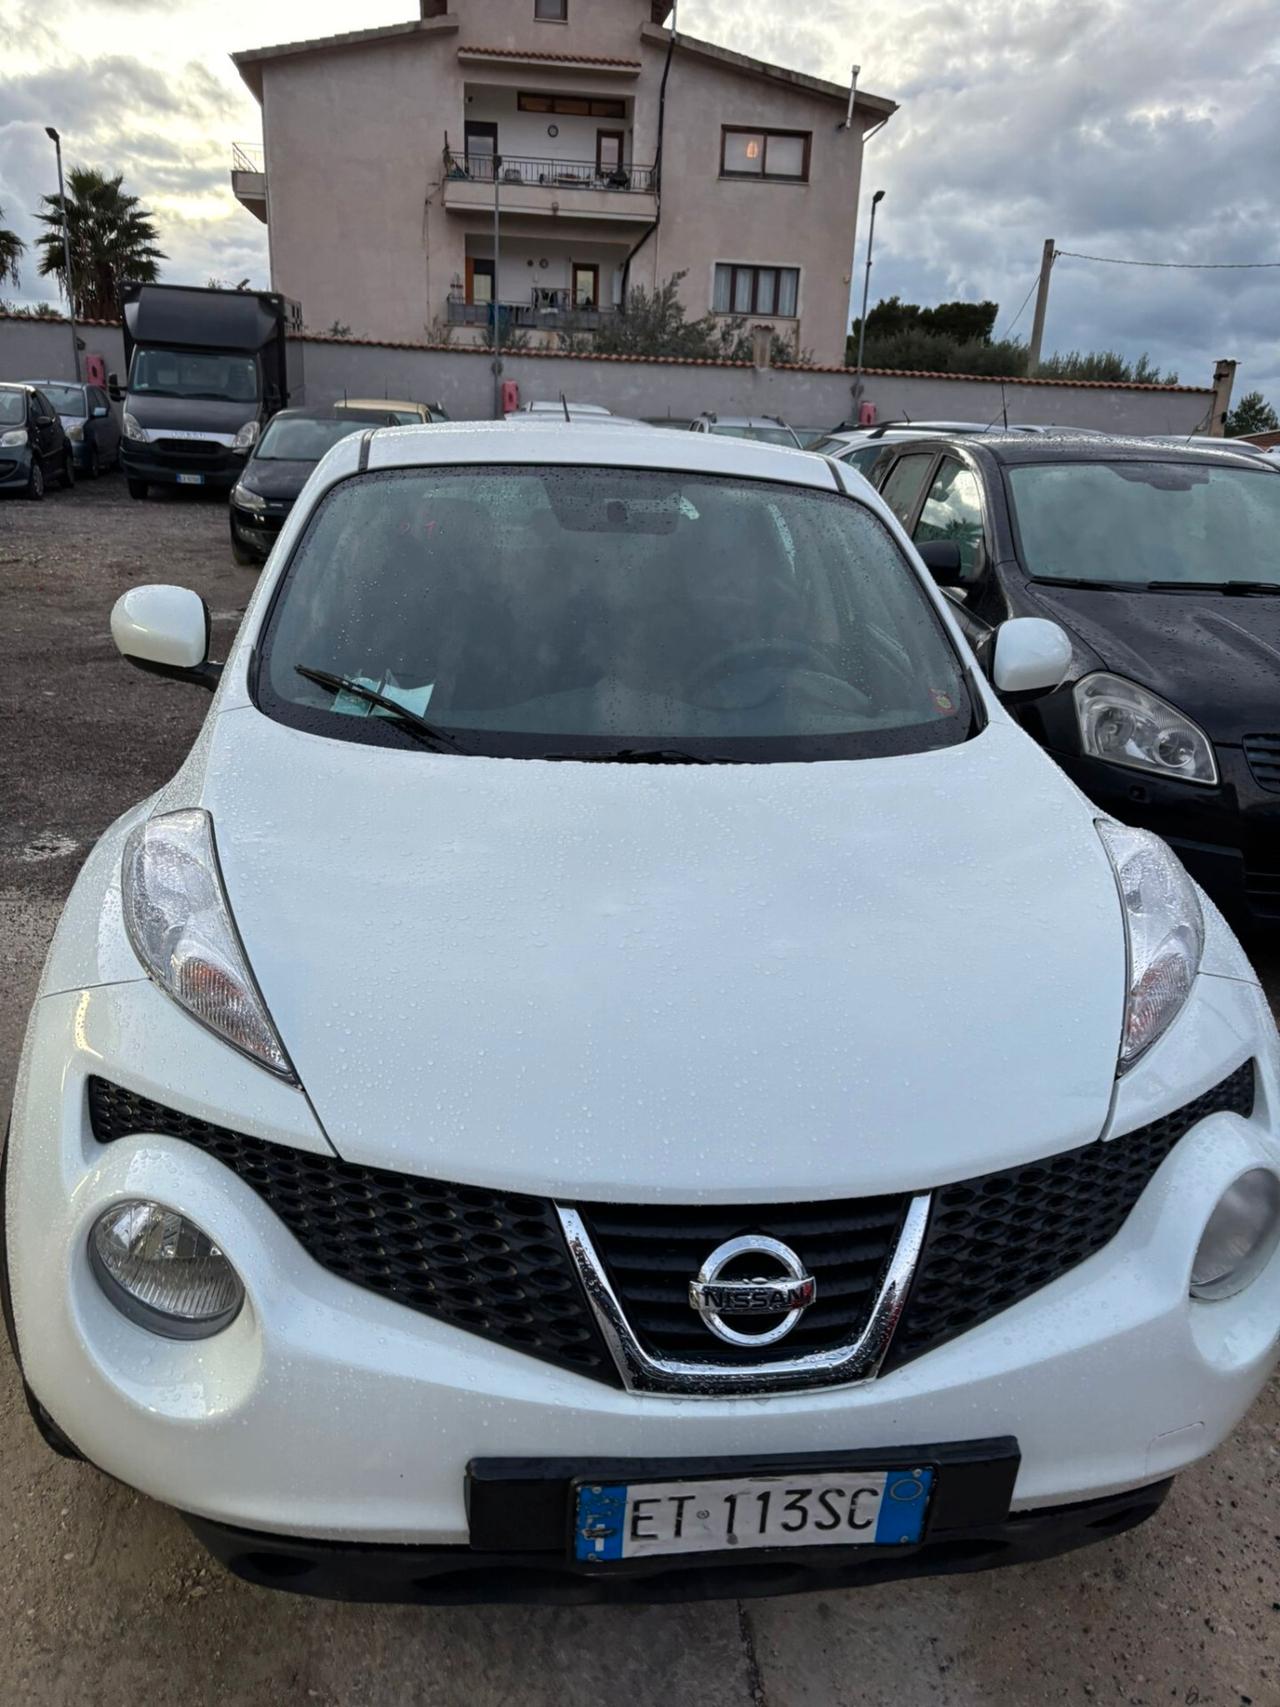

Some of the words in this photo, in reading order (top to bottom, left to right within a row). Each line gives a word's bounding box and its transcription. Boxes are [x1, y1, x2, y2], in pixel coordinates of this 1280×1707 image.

[704, 1286, 805, 1309] NISSAN
[630, 1495, 696, 1541] ET
[724, 1488, 880, 1535] 113SC
